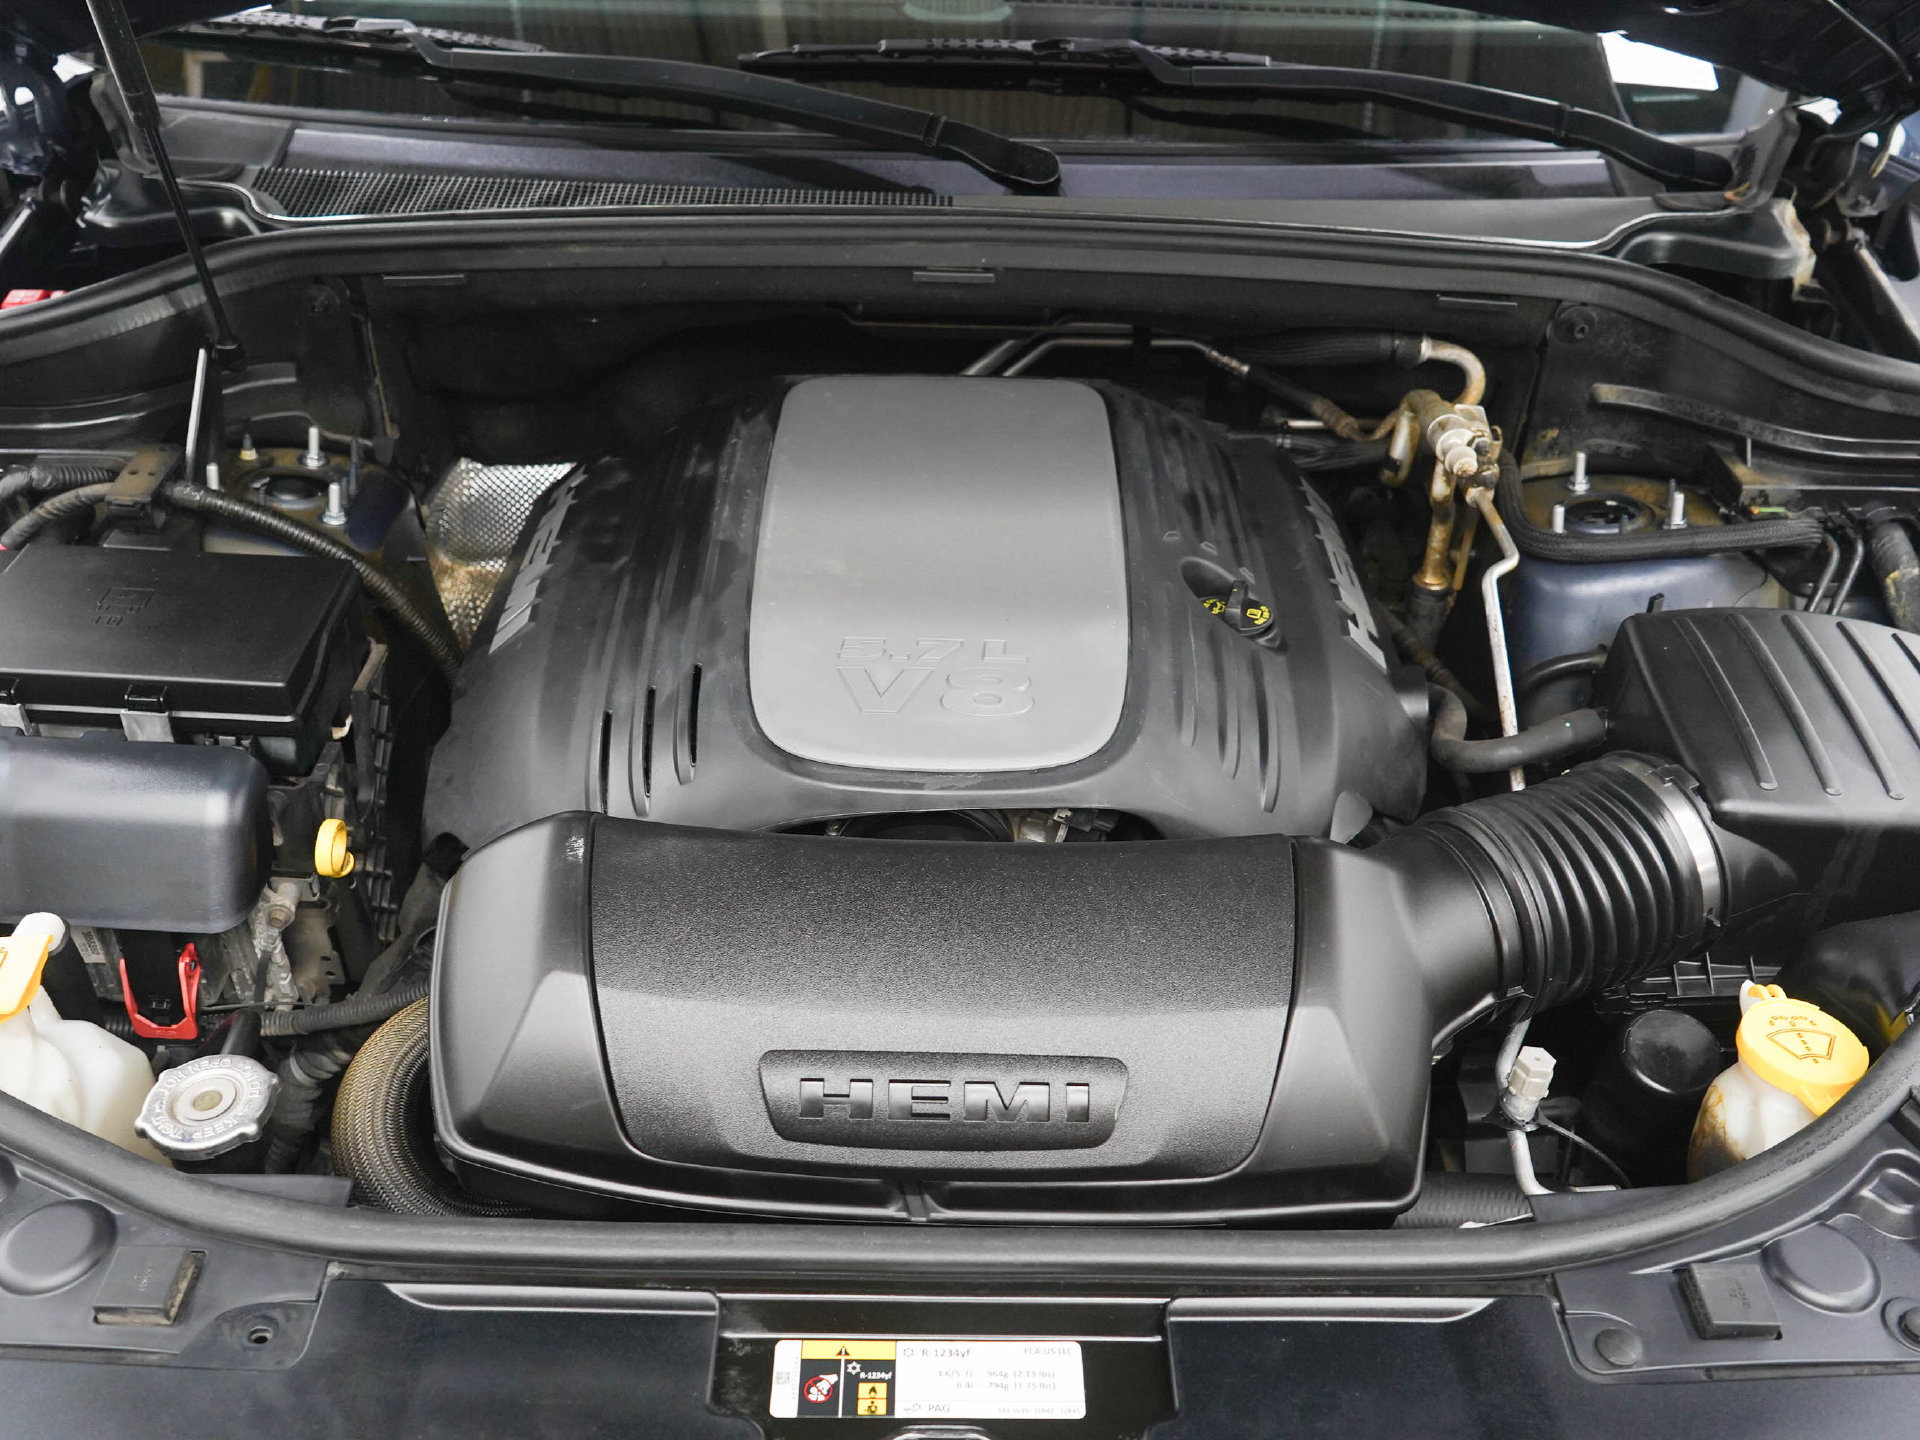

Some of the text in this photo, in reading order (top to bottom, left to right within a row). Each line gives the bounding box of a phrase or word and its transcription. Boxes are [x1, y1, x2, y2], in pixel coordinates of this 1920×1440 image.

[835, 636, 1030, 663] 5.7L
[834, 665, 1036, 717] V8
[799, 1078, 1090, 1123] HEMI
[927, 1404, 951, 1414] PAG
